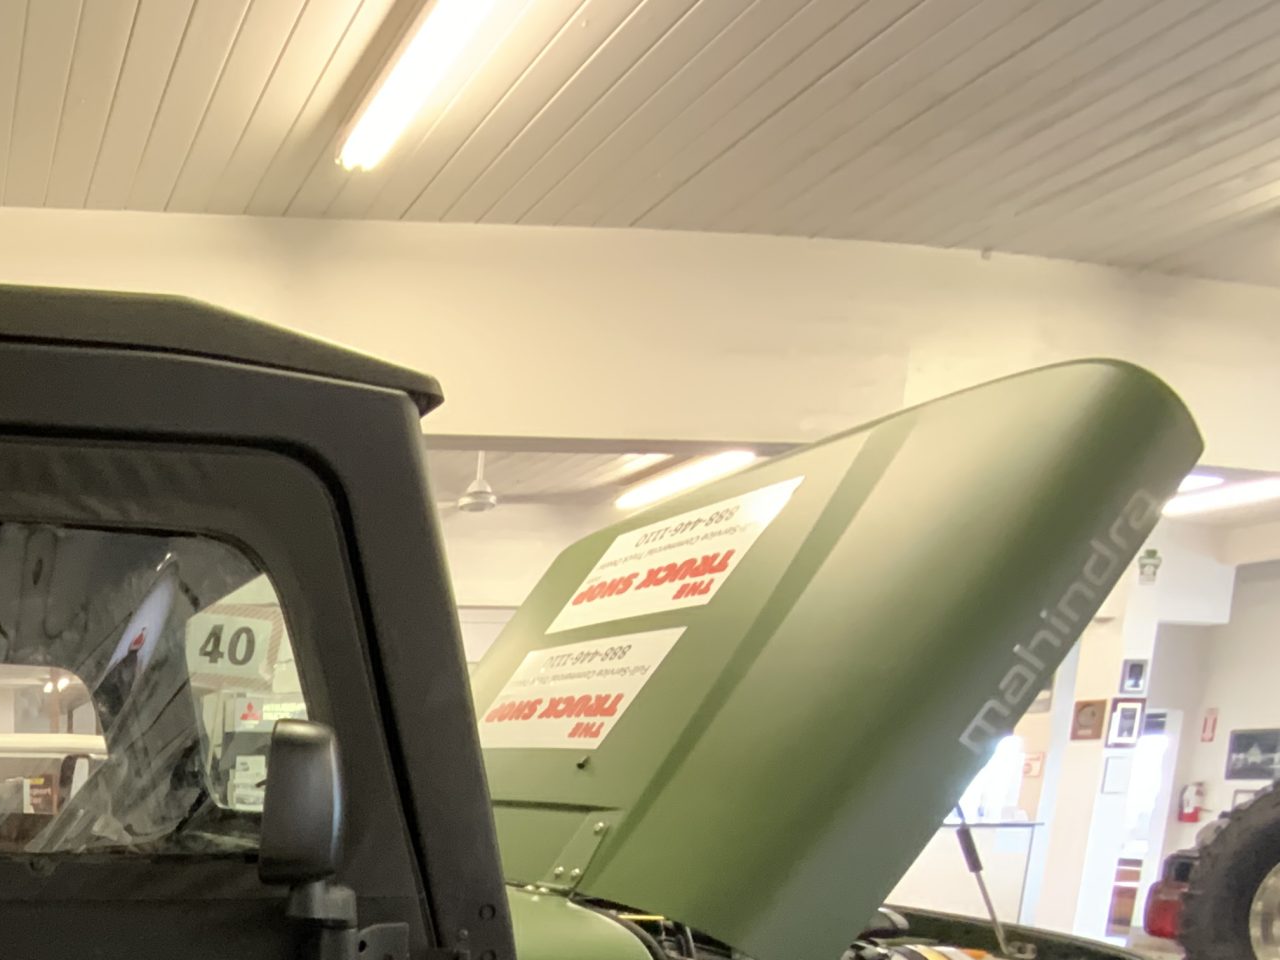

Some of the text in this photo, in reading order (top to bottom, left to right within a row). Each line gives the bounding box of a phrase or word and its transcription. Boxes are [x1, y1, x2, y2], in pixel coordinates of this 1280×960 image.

[634, 505, 741, 548] 888-446-1110
[572, 549, 736, 606] TRUCK SHOP
[672, 578, 714, 600] THE
[958, 487, 1163, 755] mahindra
[199, 624, 256, 666] 40
[485, 693, 624, 723] TRUCK SHOP
[568, 722, 605, 739] THE
